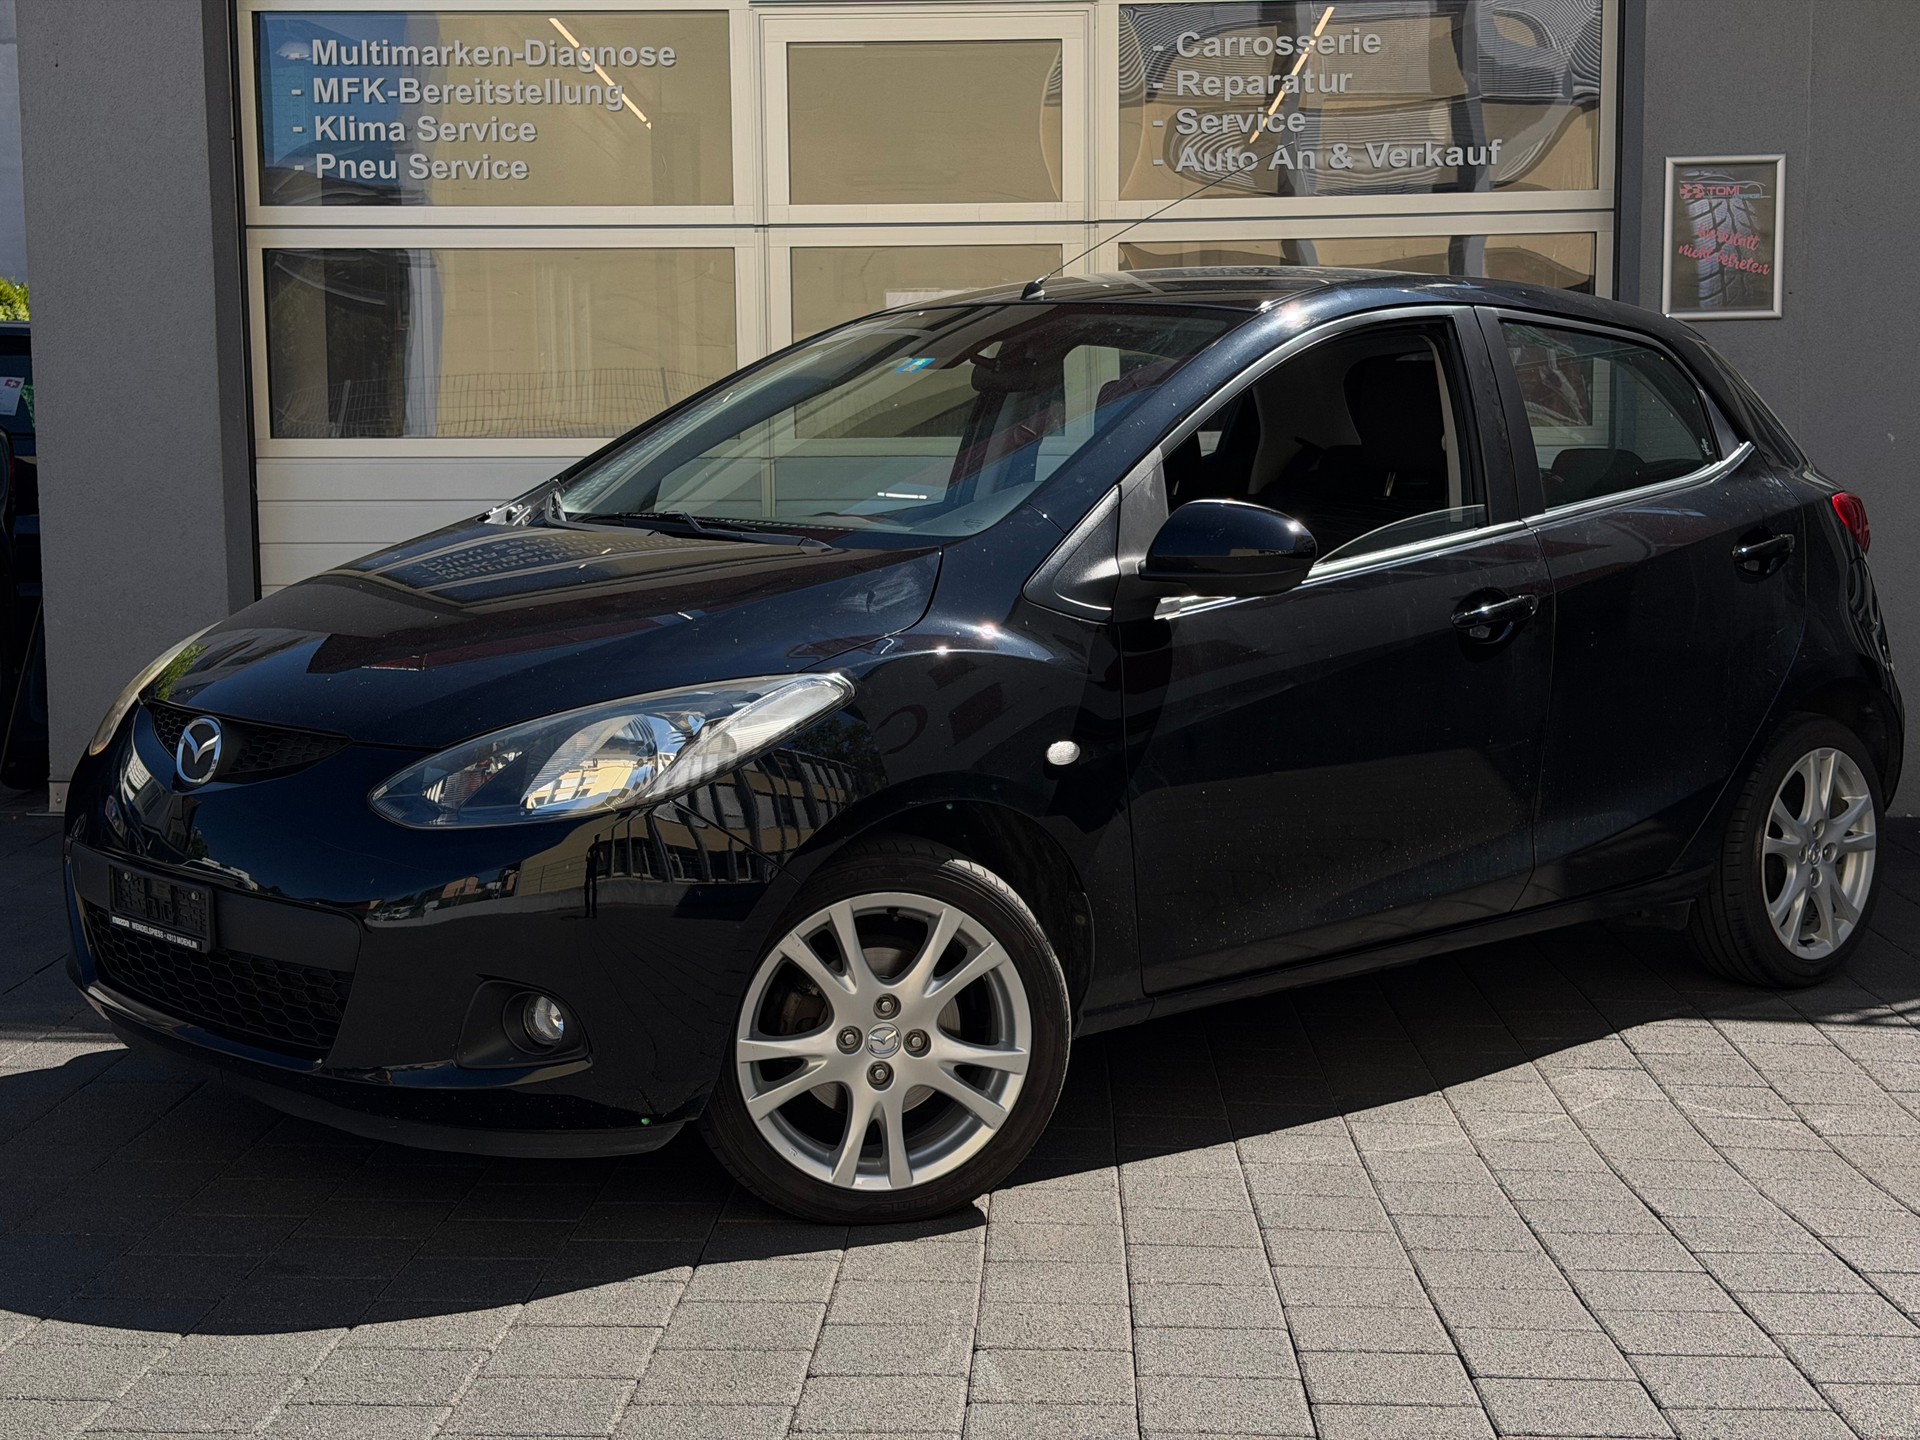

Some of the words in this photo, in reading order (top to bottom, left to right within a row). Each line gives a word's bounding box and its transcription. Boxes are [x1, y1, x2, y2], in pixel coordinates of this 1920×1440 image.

[312, 39, 676, 73] Multimarken-Diagnose
[1176, 28, 1382, 57] Carrosserie
[313, 77, 624, 111] MFK-Bereitstellung
[1177, 70, 1352, 102] Reparatur
[315, 115, 406, 142] Klima
[417, 115, 537, 142] Service
[1176, 107, 1306, 135] Service
[316, 153, 398, 180] Pneu
[409, 153, 529, 180] Service
[1175, 146, 1258, 172] Auto
[1268, 145, 1316, 171] An
[1329, 143, 1353, 169] &
[1365, 139, 1503, 168] Verkauf
[1707, 186, 1740, 196] TOMI
[1716, 249, 1770, 275] betreten
